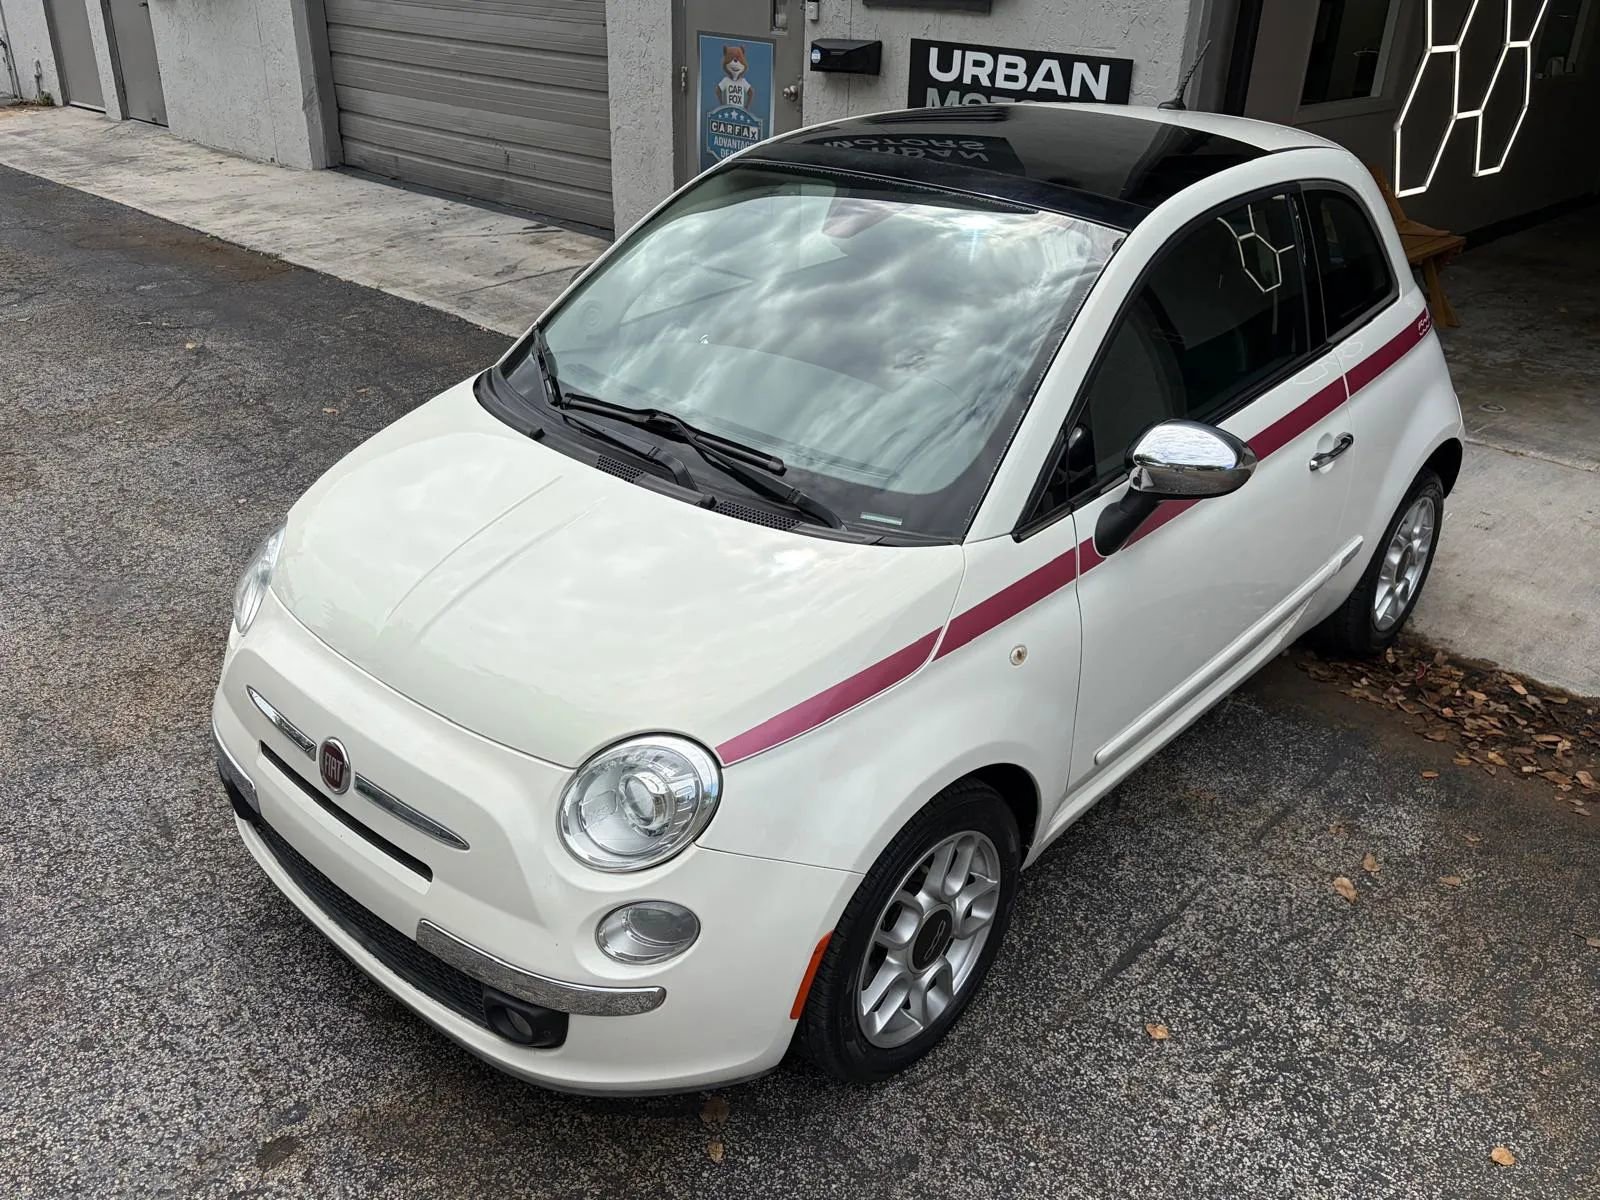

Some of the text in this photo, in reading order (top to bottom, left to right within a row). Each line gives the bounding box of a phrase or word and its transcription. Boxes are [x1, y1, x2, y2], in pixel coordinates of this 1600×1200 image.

[928, 47, 1110, 101] URBAN
[728, 85, 742, 95] CAR
[729, 95, 742, 104] FOX
[711, 121, 758, 140] CARFAX
[714, 136, 756, 150] ADVANTAG
[324, 751, 343, 782] FIAT
